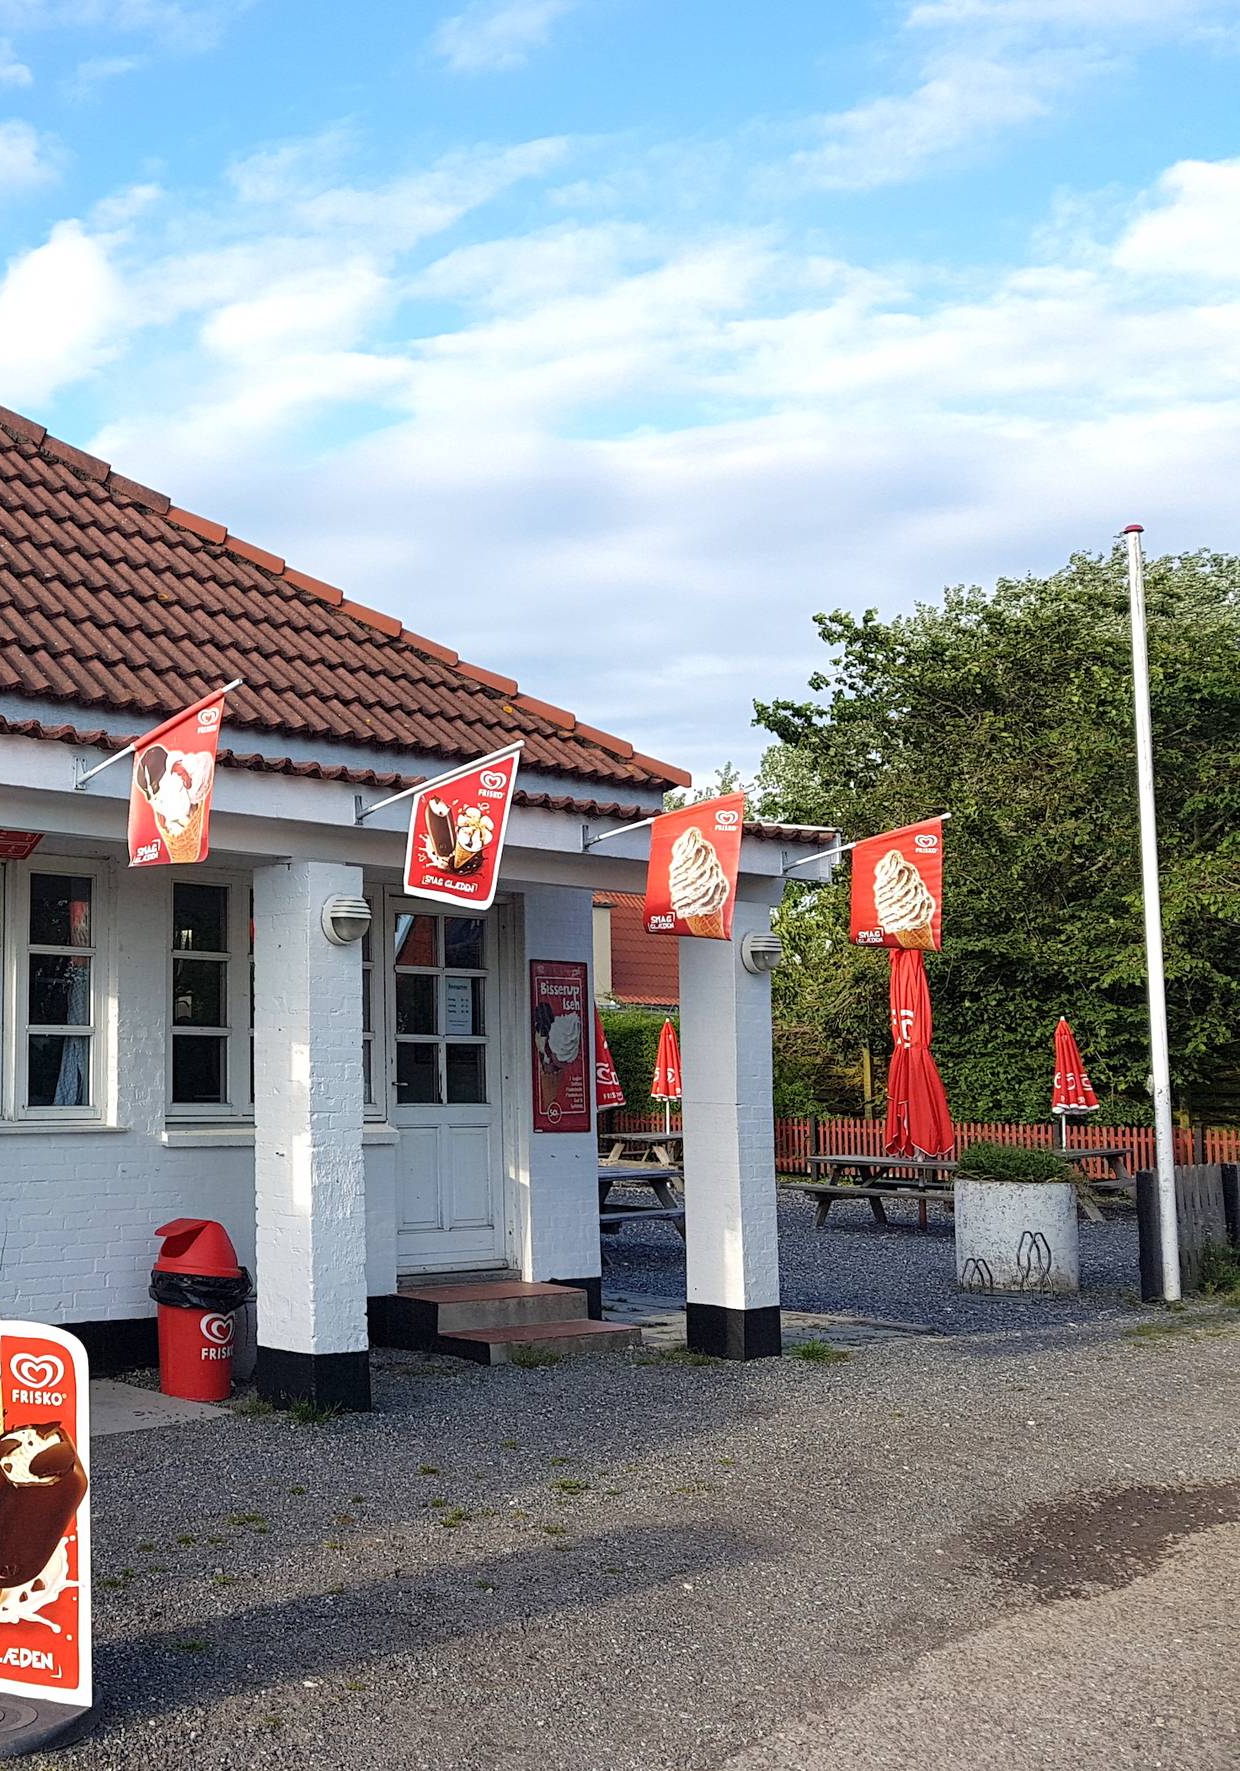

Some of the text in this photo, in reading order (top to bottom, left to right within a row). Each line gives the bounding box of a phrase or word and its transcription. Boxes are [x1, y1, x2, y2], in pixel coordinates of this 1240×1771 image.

[650, 915, 672, 924] SMAG
[858, 930, 881, 938] SMAG
[540, 981, 580, 1003] Bisserup
[11, 1389, 64, 1407] FRISKO
